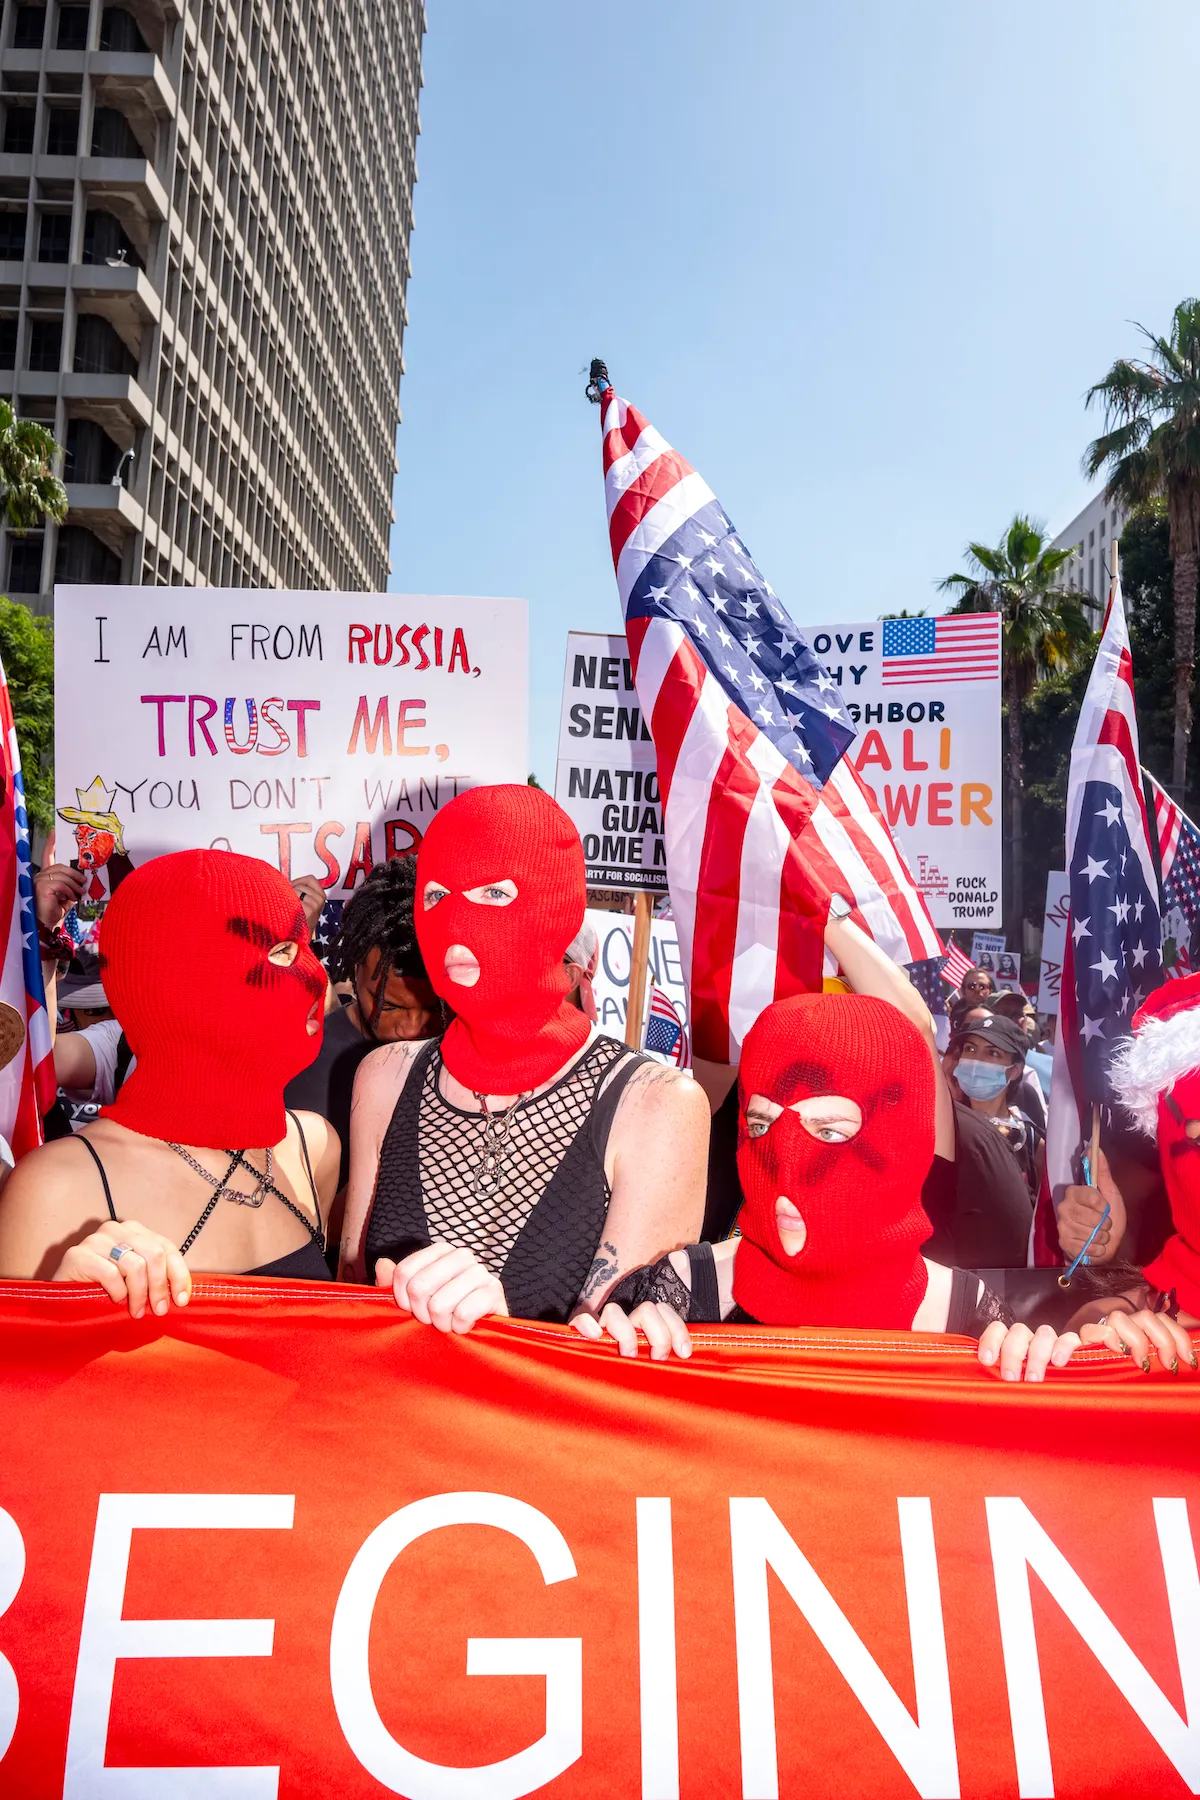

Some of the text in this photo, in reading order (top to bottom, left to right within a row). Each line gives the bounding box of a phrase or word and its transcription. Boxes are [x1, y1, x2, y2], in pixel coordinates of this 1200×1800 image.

[94, 617, 482, 678] I AM FROM RUSSIA,
[813, 631, 874, 654] OVE
[140, 695, 450, 762] TRUST ME,
[854, 727, 951, 771] ALI
[115, 775, 471, 813] YOU DON'T WANT
[601, 804, 665, 835] GUA
[606, 870, 623, 881] FOR
[956, 876, 987, 889] FUCK
[948, 891, 998, 903] DONALD
[952, 905, 994, 918] TRUMP
[975, 942, 1003, 952] IS NOT
[0, 1491, 1200, 1800] EGINN
